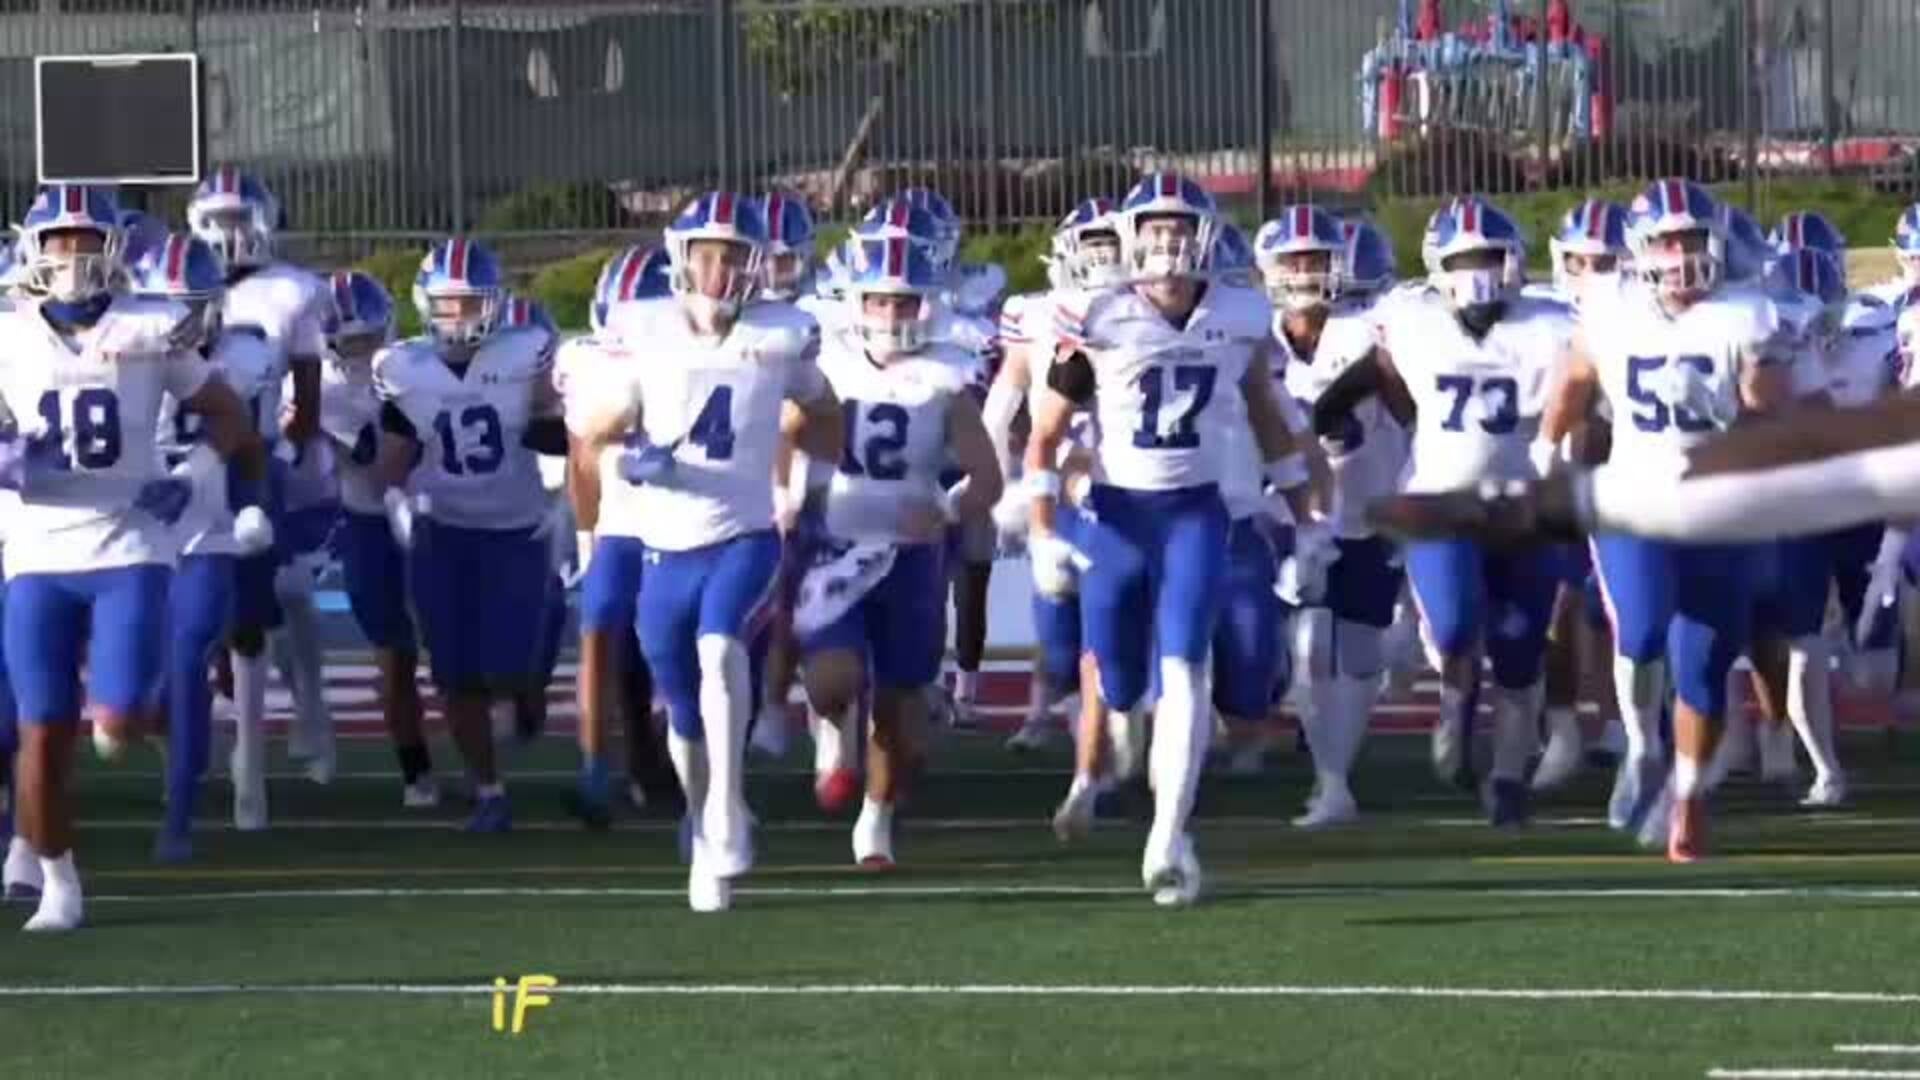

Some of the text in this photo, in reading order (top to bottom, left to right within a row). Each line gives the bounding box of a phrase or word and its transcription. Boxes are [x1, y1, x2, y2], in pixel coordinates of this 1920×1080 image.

[38, 390, 120, 469] 18
[433, 406, 503, 475] 13
[689, 385, 735, 460] 4
[841, 399, 910, 480] 12
[1132, 366, 1217, 448] 17
[1436, 376, 1519, 434] 73
